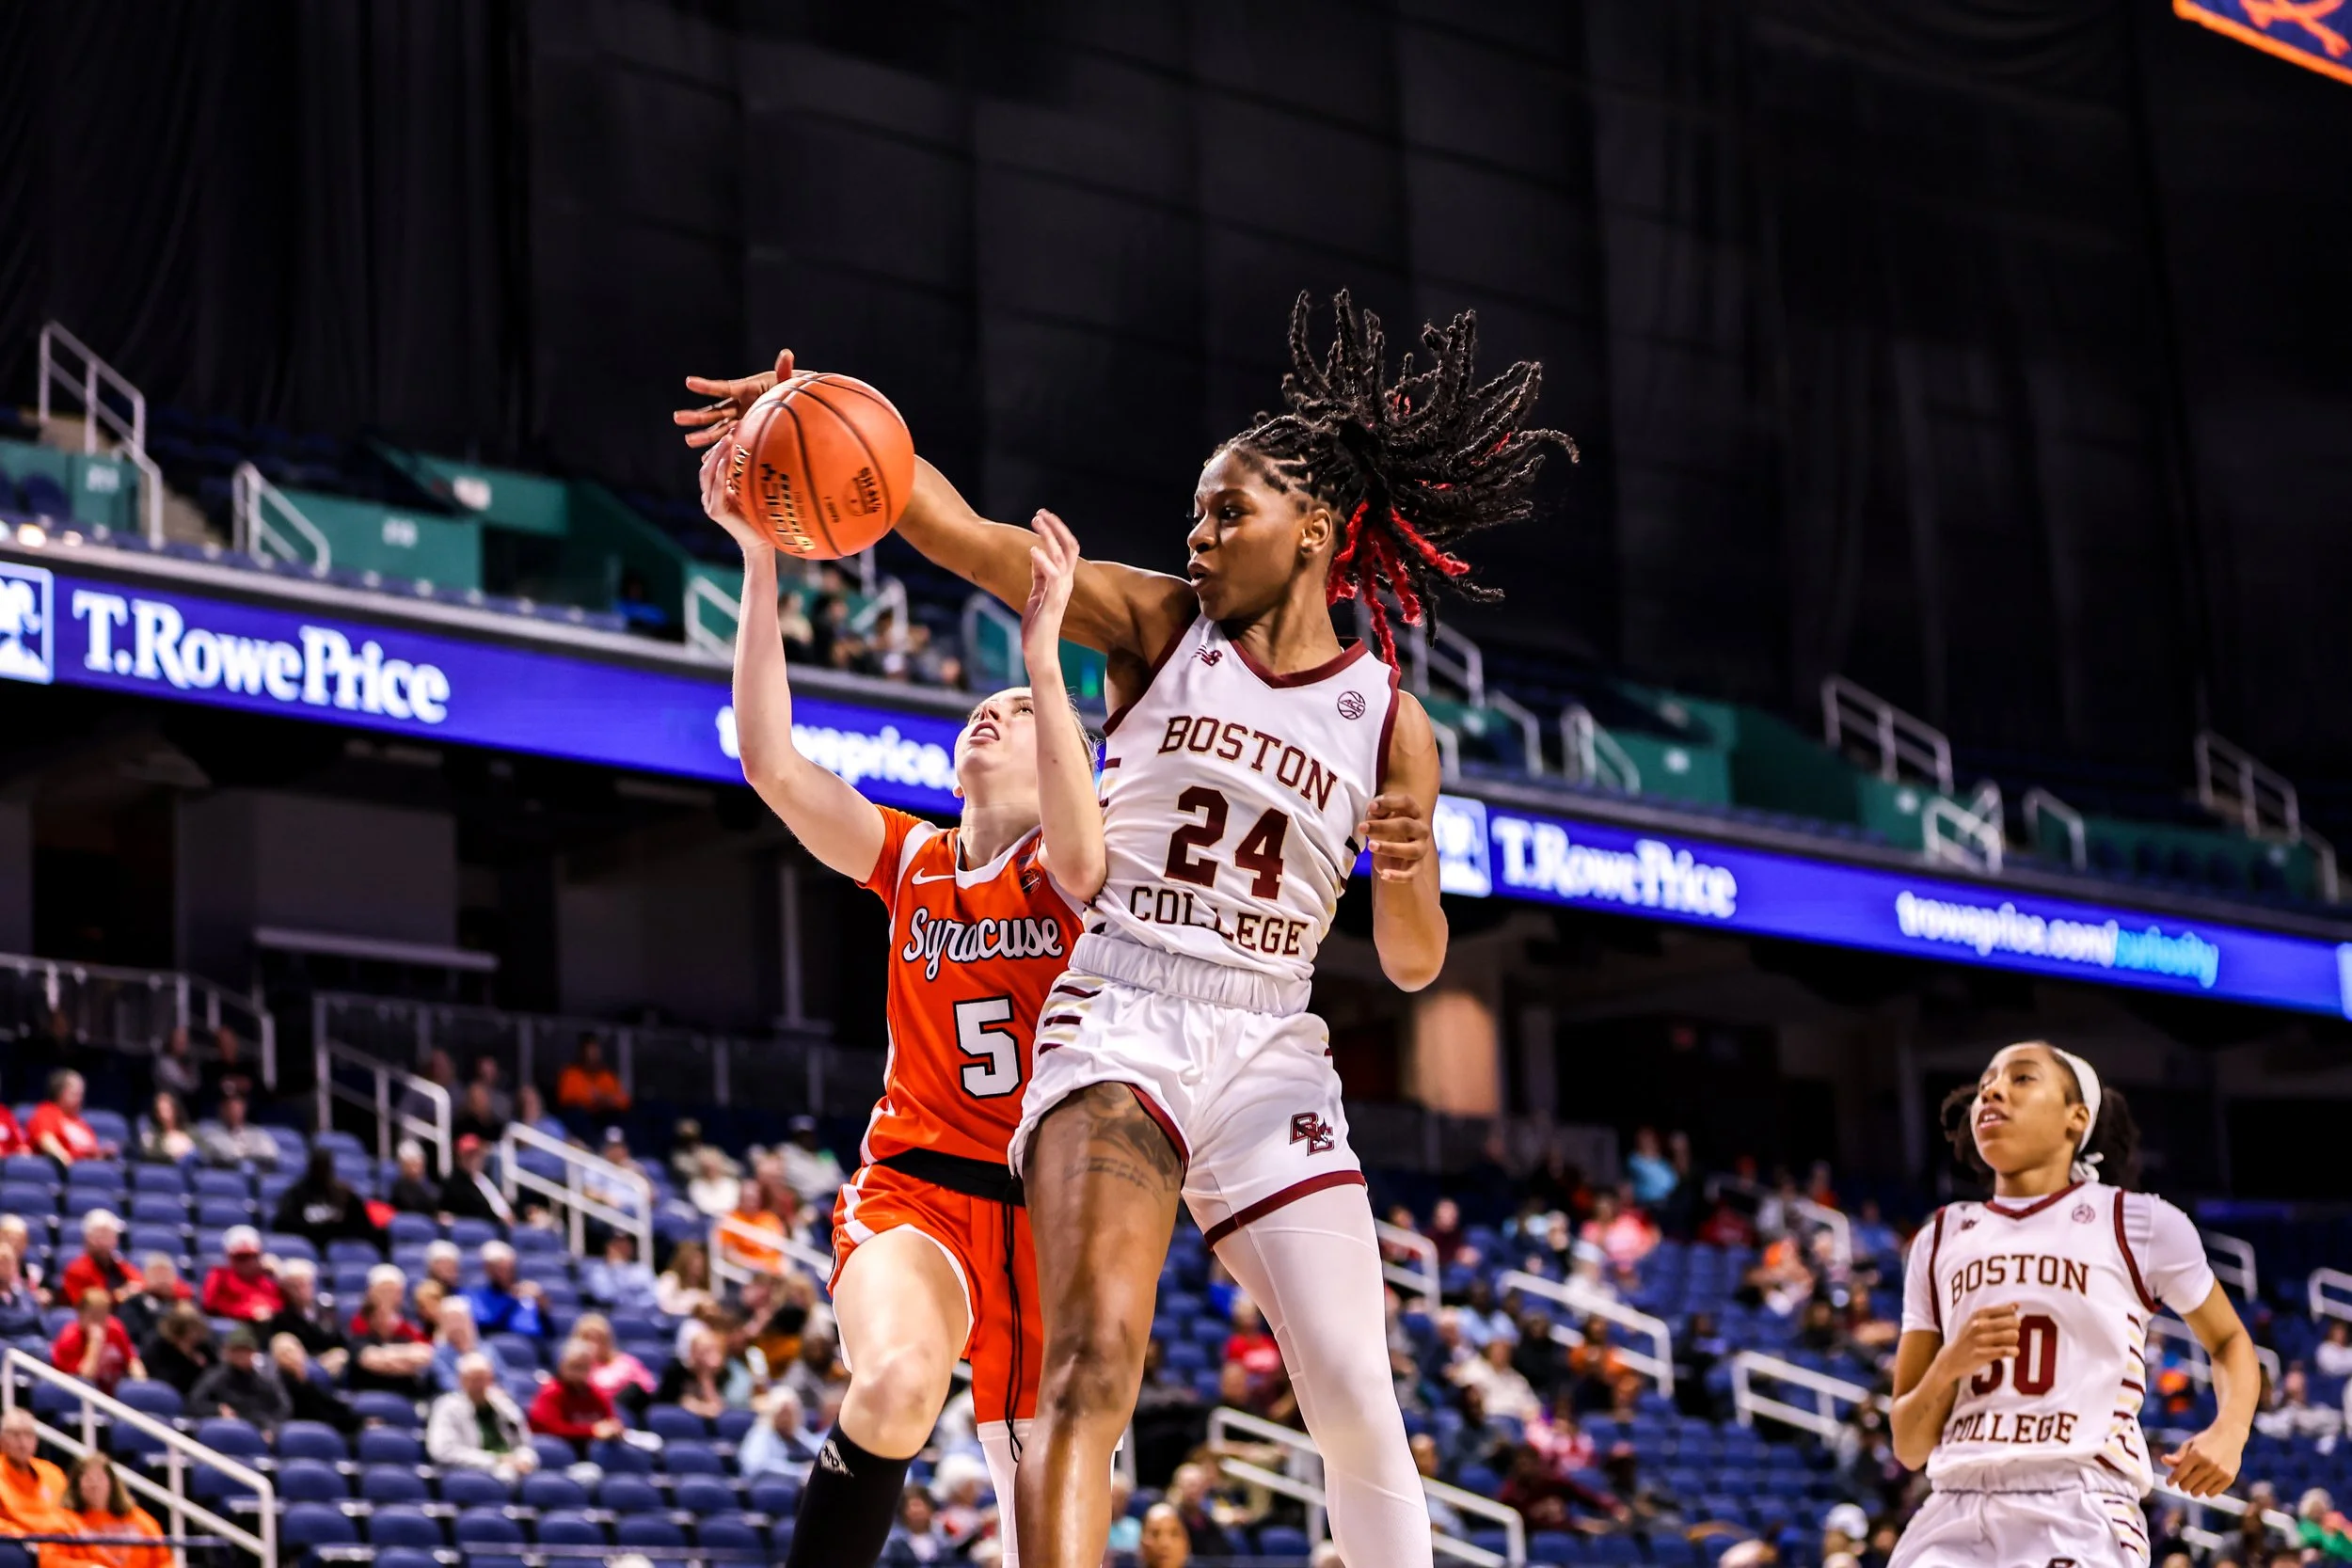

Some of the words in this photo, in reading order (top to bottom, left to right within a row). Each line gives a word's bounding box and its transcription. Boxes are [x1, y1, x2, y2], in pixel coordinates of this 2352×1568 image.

[1158, 716, 1337, 813] BOSTON
[1164, 785, 1289, 901] 24
[902, 907, 1063, 981] Syracuse
[1129, 885, 1309, 956] COLLEGE
[954, 994, 1023, 1100] 5
[1950, 1254, 2090, 1307] BOSTON
[1947, 1411, 2078, 1445] COLLEGE
